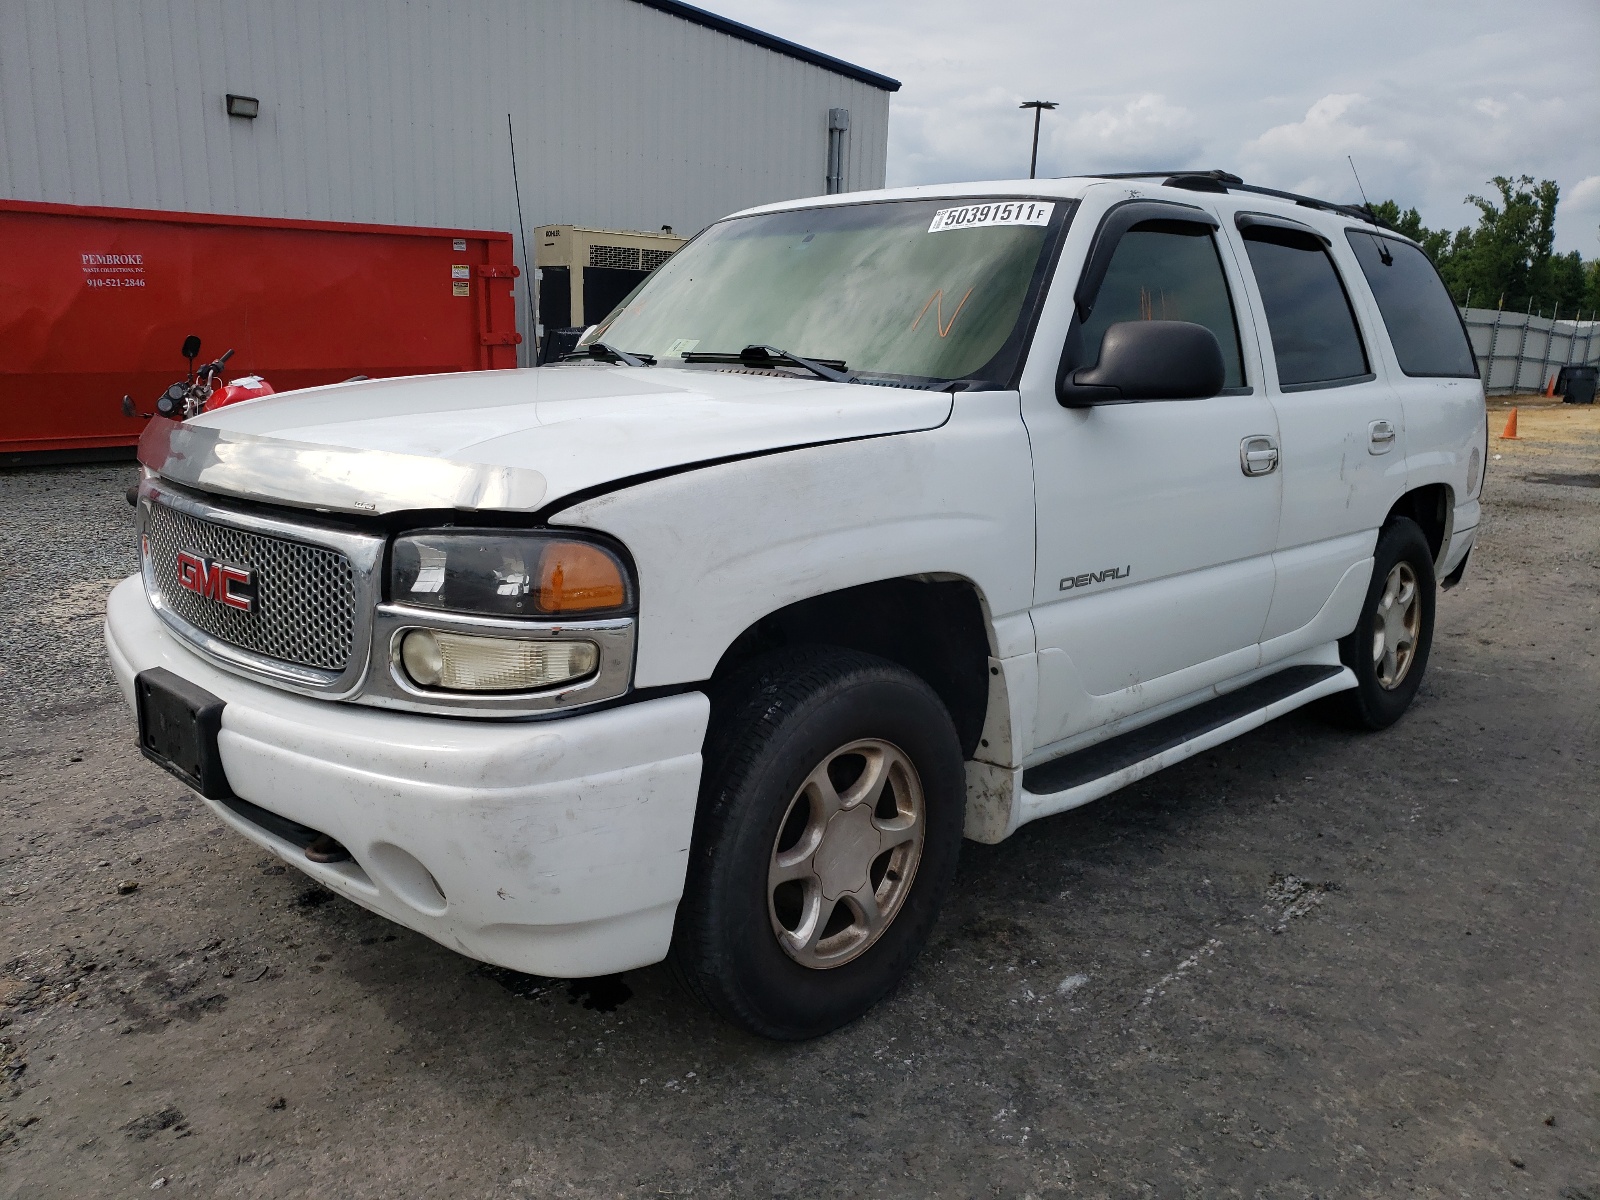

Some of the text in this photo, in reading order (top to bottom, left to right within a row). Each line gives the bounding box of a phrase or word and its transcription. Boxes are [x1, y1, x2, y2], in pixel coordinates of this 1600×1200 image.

[82, 254, 144, 265] PEMBROKE
[87, 278, 146, 287] 910-521-2846
[177, 550, 252, 612] GMC
[1059, 564, 1131, 591] DENALI
